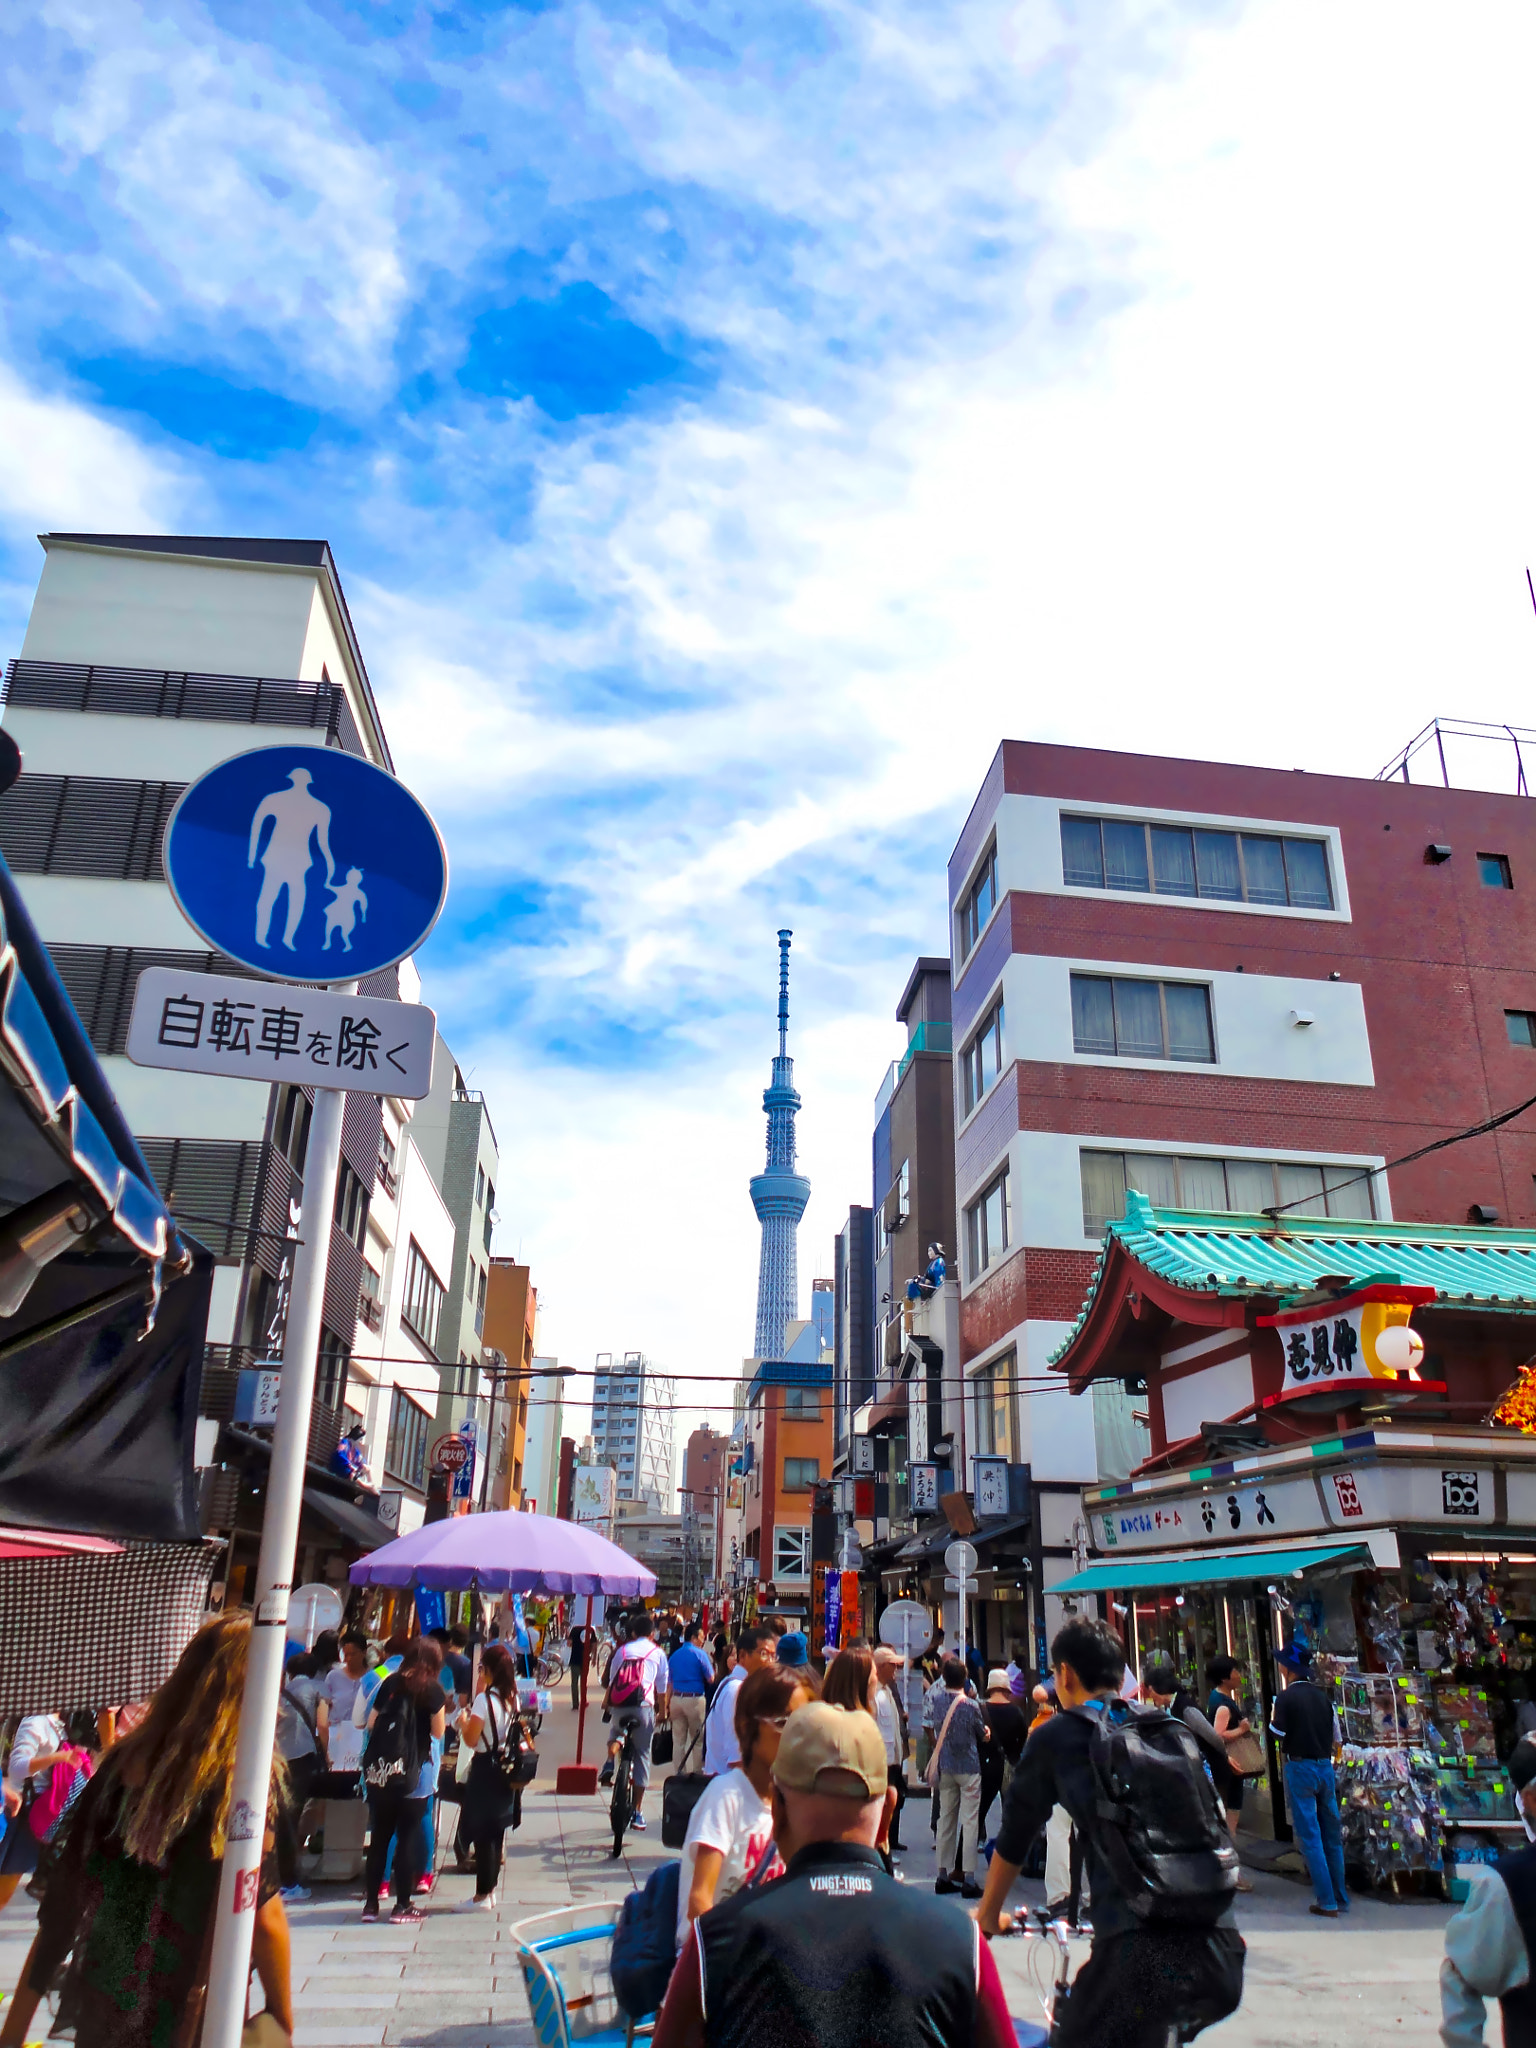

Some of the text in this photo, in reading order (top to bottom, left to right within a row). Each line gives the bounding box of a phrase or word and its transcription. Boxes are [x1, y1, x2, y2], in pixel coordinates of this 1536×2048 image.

[158, 993, 410, 1075] 自転車を除く
[260, 1375, 272, 1415] かりんとう
[441, 1449, 465, 1462] 消火栓
[861, 1440, 869, 1468] にしだ
[1155, 1510, 1182, 1529] ゲーム
[810, 1875, 872, 1891] VINGT-TROIS
